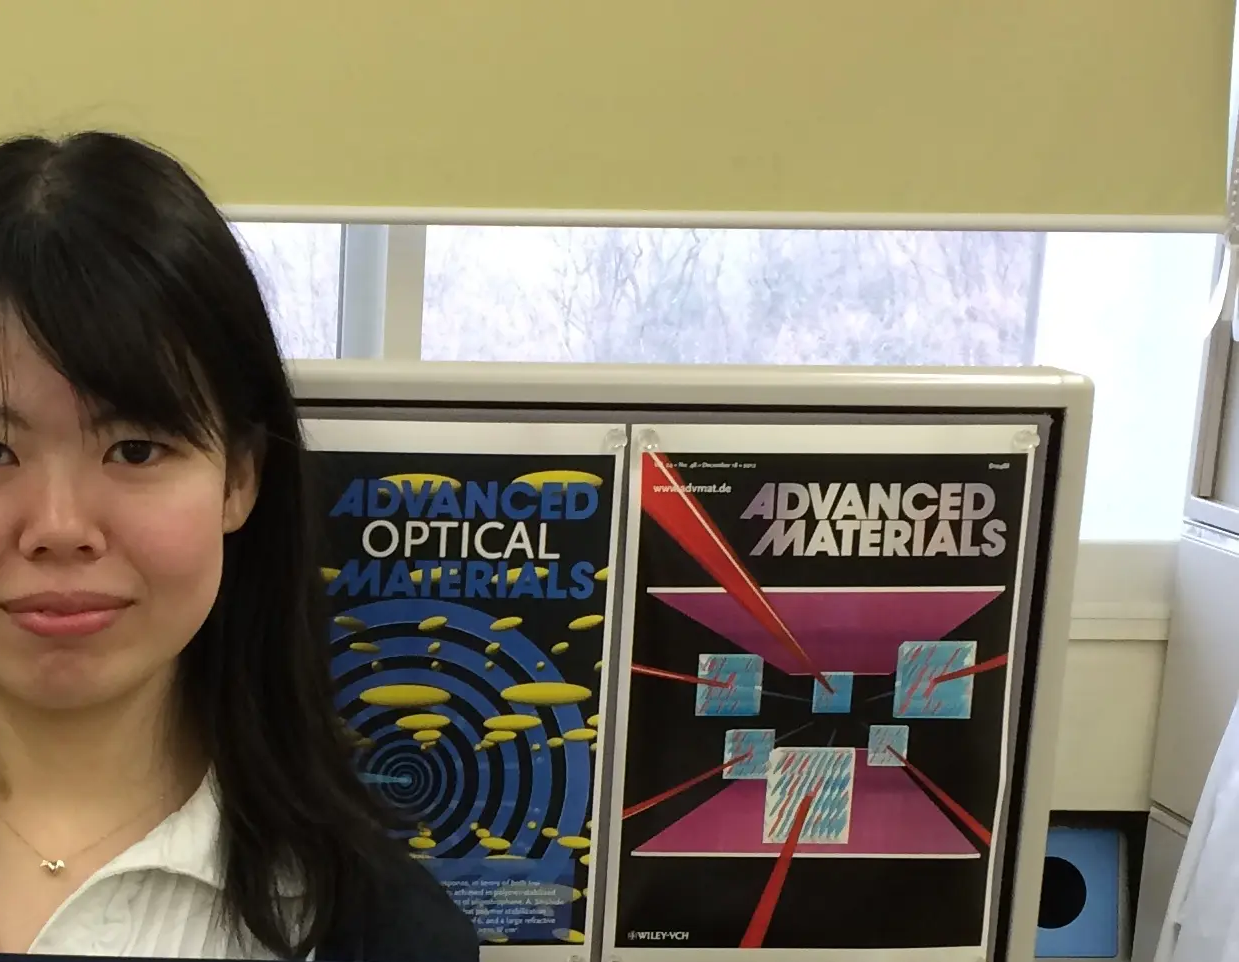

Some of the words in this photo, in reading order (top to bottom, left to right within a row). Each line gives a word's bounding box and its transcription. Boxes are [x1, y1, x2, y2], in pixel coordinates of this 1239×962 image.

[329, 479, 599, 520] ADVANCED
[653, 482, 732, 494] www.advmat.de
[740, 482, 995, 521] ADVANCED
[362, 520, 560, 559] OPTICAL
[750, 519, 1006, 558] MATERIALS
[326, 560, 595, 600] MATERIALS
[637, 930, 689, 941] WILEY-VCH
